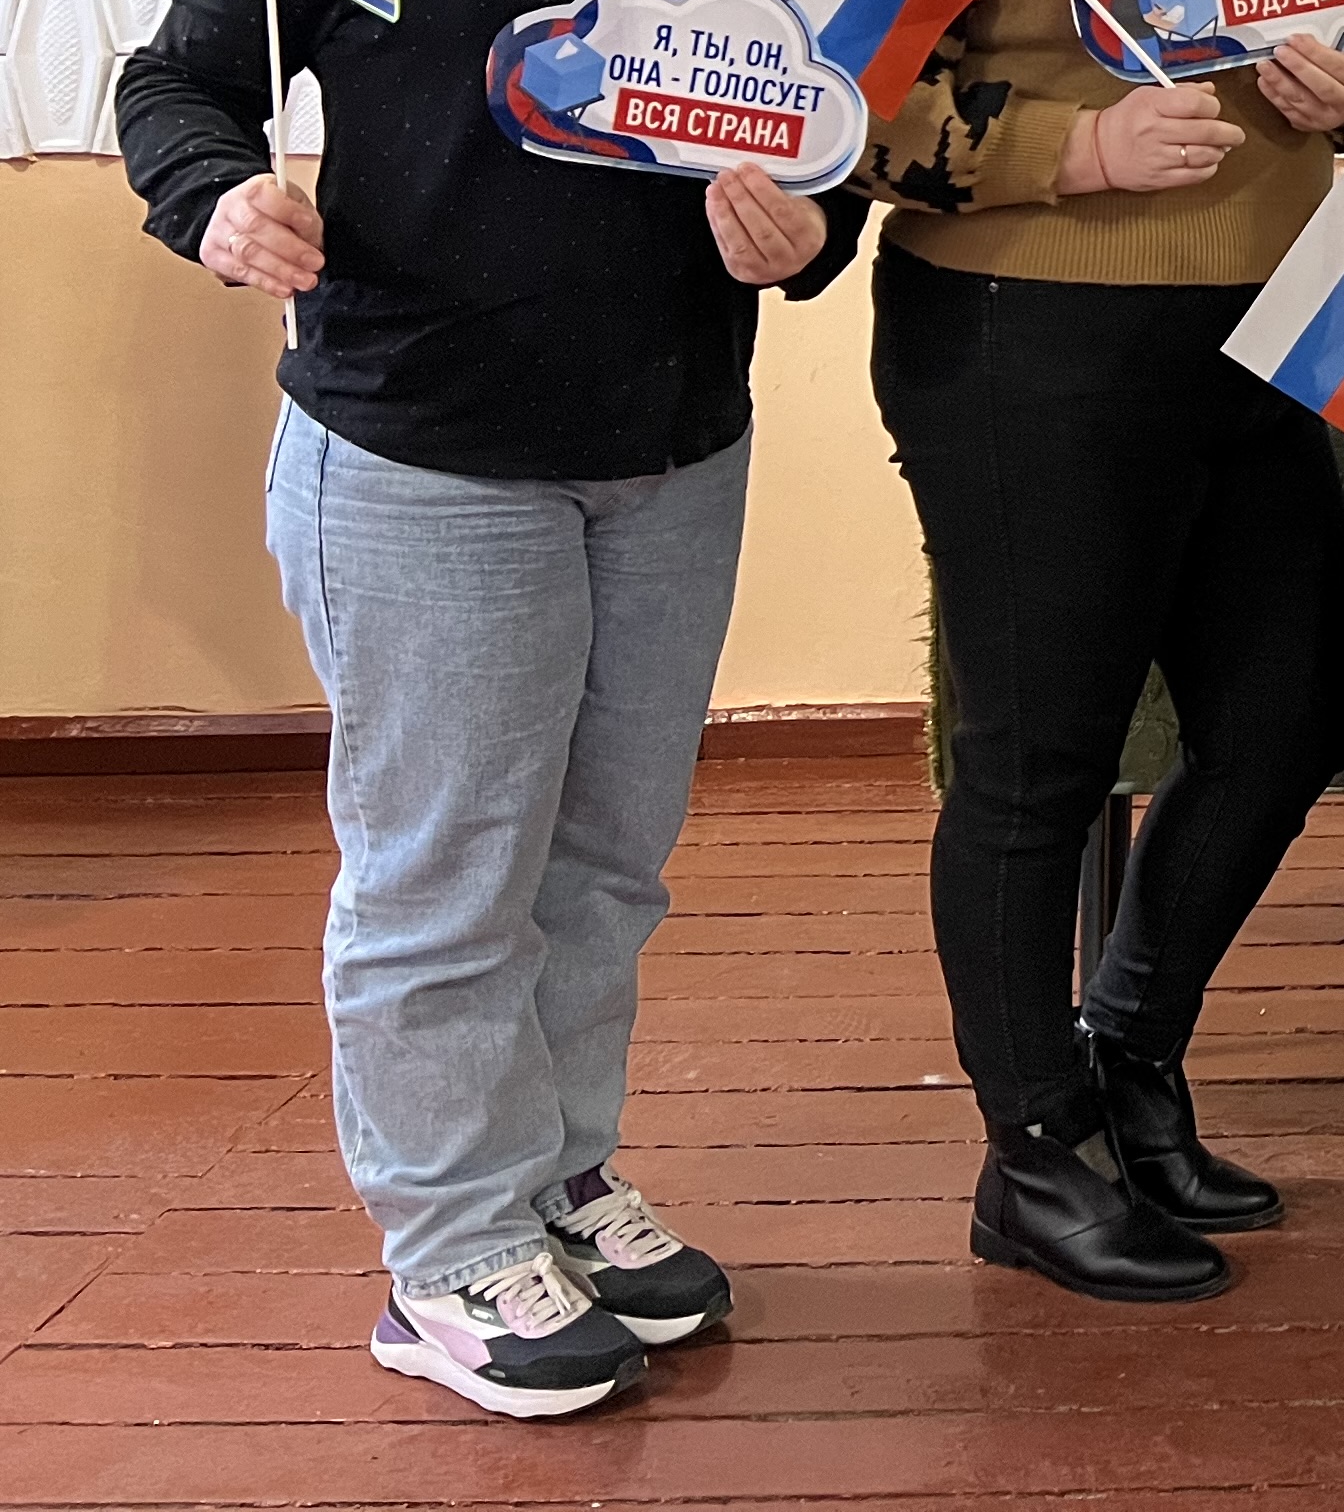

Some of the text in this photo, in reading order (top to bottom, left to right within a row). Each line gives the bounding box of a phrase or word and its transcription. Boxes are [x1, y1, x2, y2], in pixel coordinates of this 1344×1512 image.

[653, 24, 788, 76] Я, ТЫ, ОН,
[608, 54, 661, 88] ОНА
[688, 67, 825, 112] ГОЛОСУЕТ
[626, 98, 789, 150] ВСЯ СТРАНА
